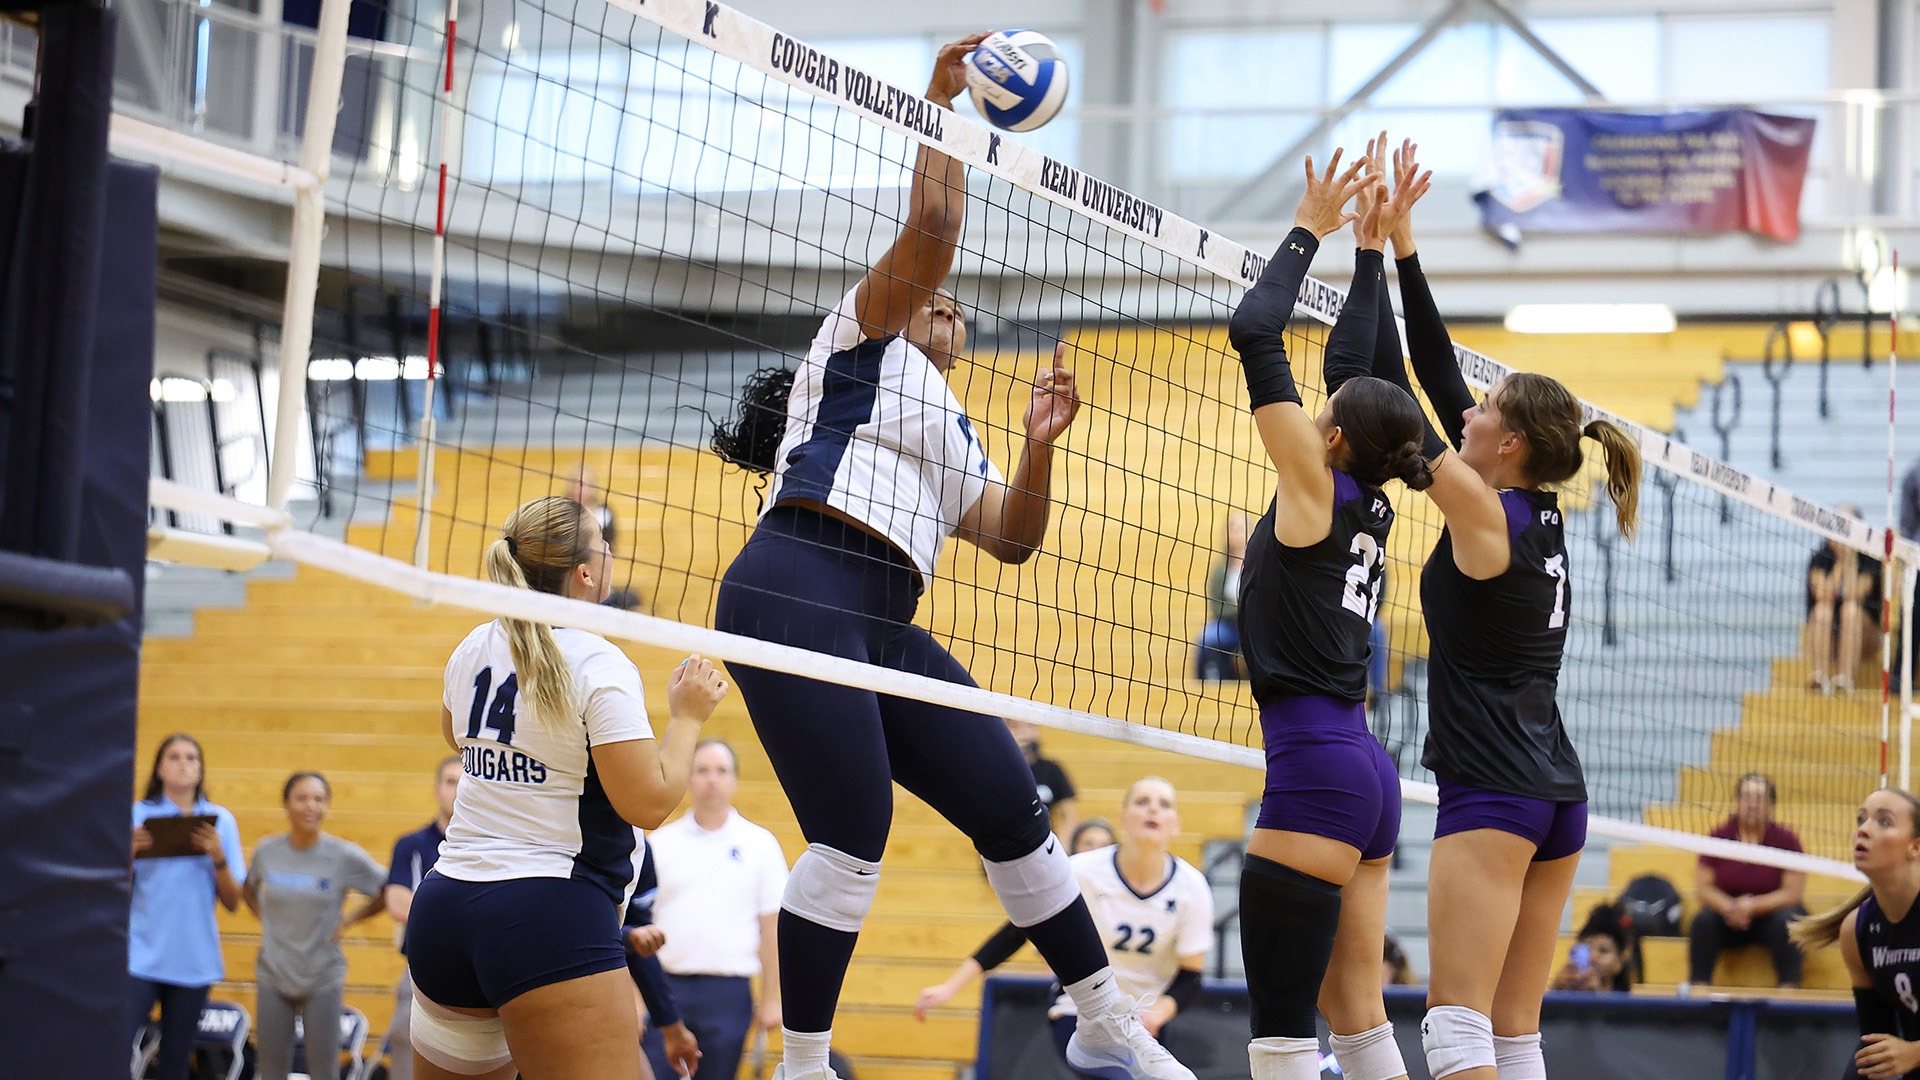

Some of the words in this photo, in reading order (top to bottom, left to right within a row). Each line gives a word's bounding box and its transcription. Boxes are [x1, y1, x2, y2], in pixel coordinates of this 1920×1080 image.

[771, 32, 839, 95] COUGAR
[844, 65, 943, 142] VOLLEYBALL
[1040, 155, 1079, 201] KEAN
[1081, 174, 1163, 238] UNIVERSITY
[1240, 249, 1269, 284] COU
[466, 664, 519, 745] 14
[462, 746, 547, 784] OUGARS
[1112, 924, 1156, 954] 22
[1894, 972, 1918, 1014] 8
